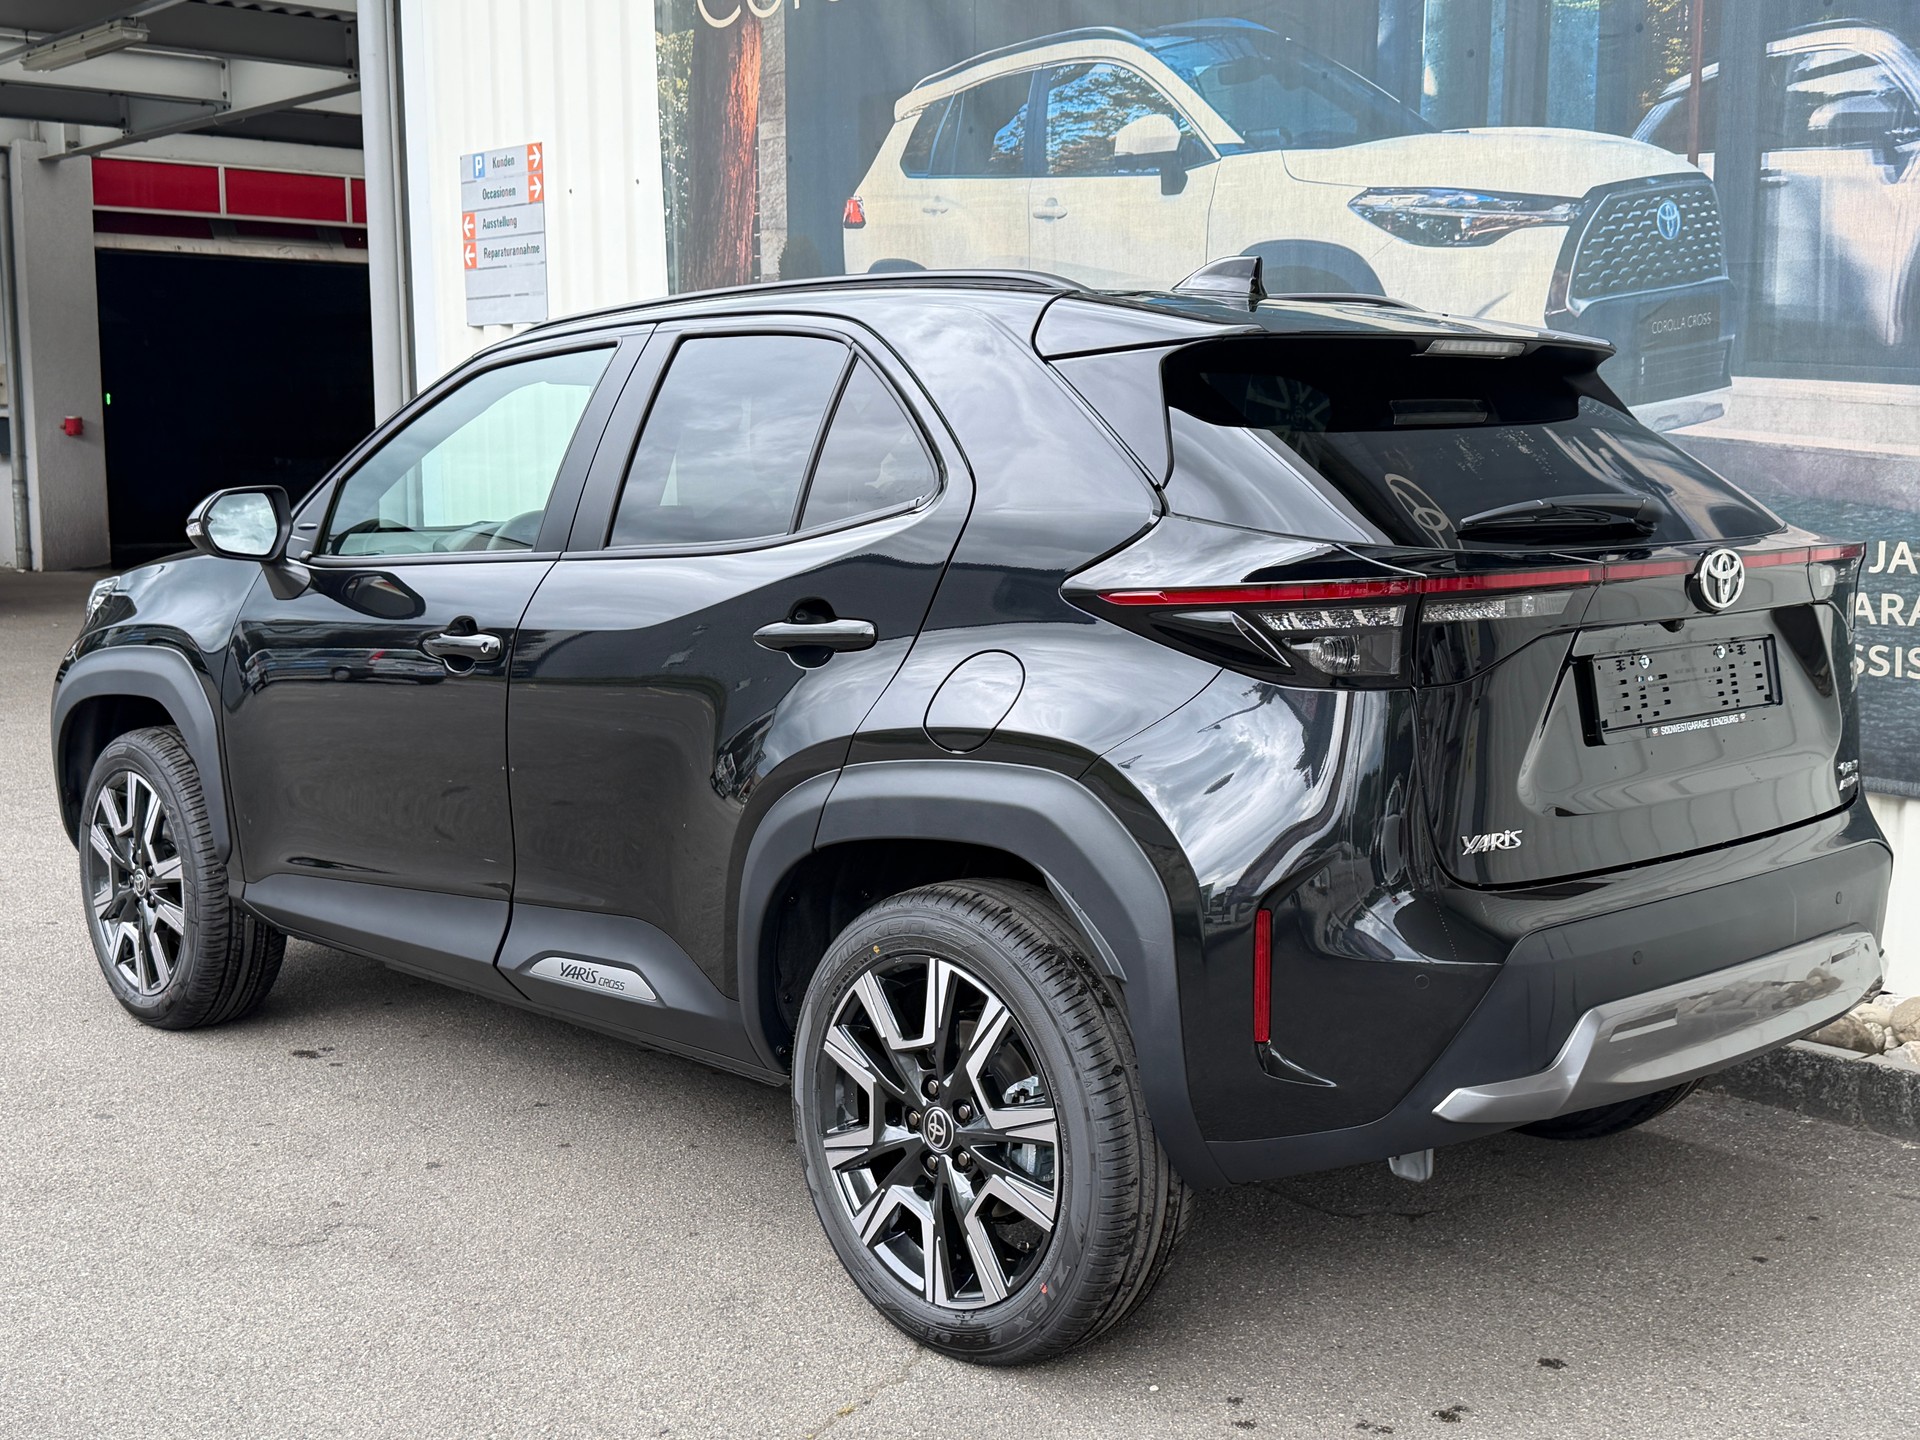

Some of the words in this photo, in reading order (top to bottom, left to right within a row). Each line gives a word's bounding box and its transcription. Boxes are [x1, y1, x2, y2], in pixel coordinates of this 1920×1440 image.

[492, 155, 515, 168] Kunden
[482, 186, 516, 200] Occasionen
[482, 216, 517, 230] Ausstellung
[483, 243, 540, 260] Reparaturannahme
[1651, 317, 1686, 334] COROLLA
[1687, 312, 1712, 328] CROSS
[1710, 714, 1739, 727] LENZBURG
[598, 976, 625, 991] CROSS
